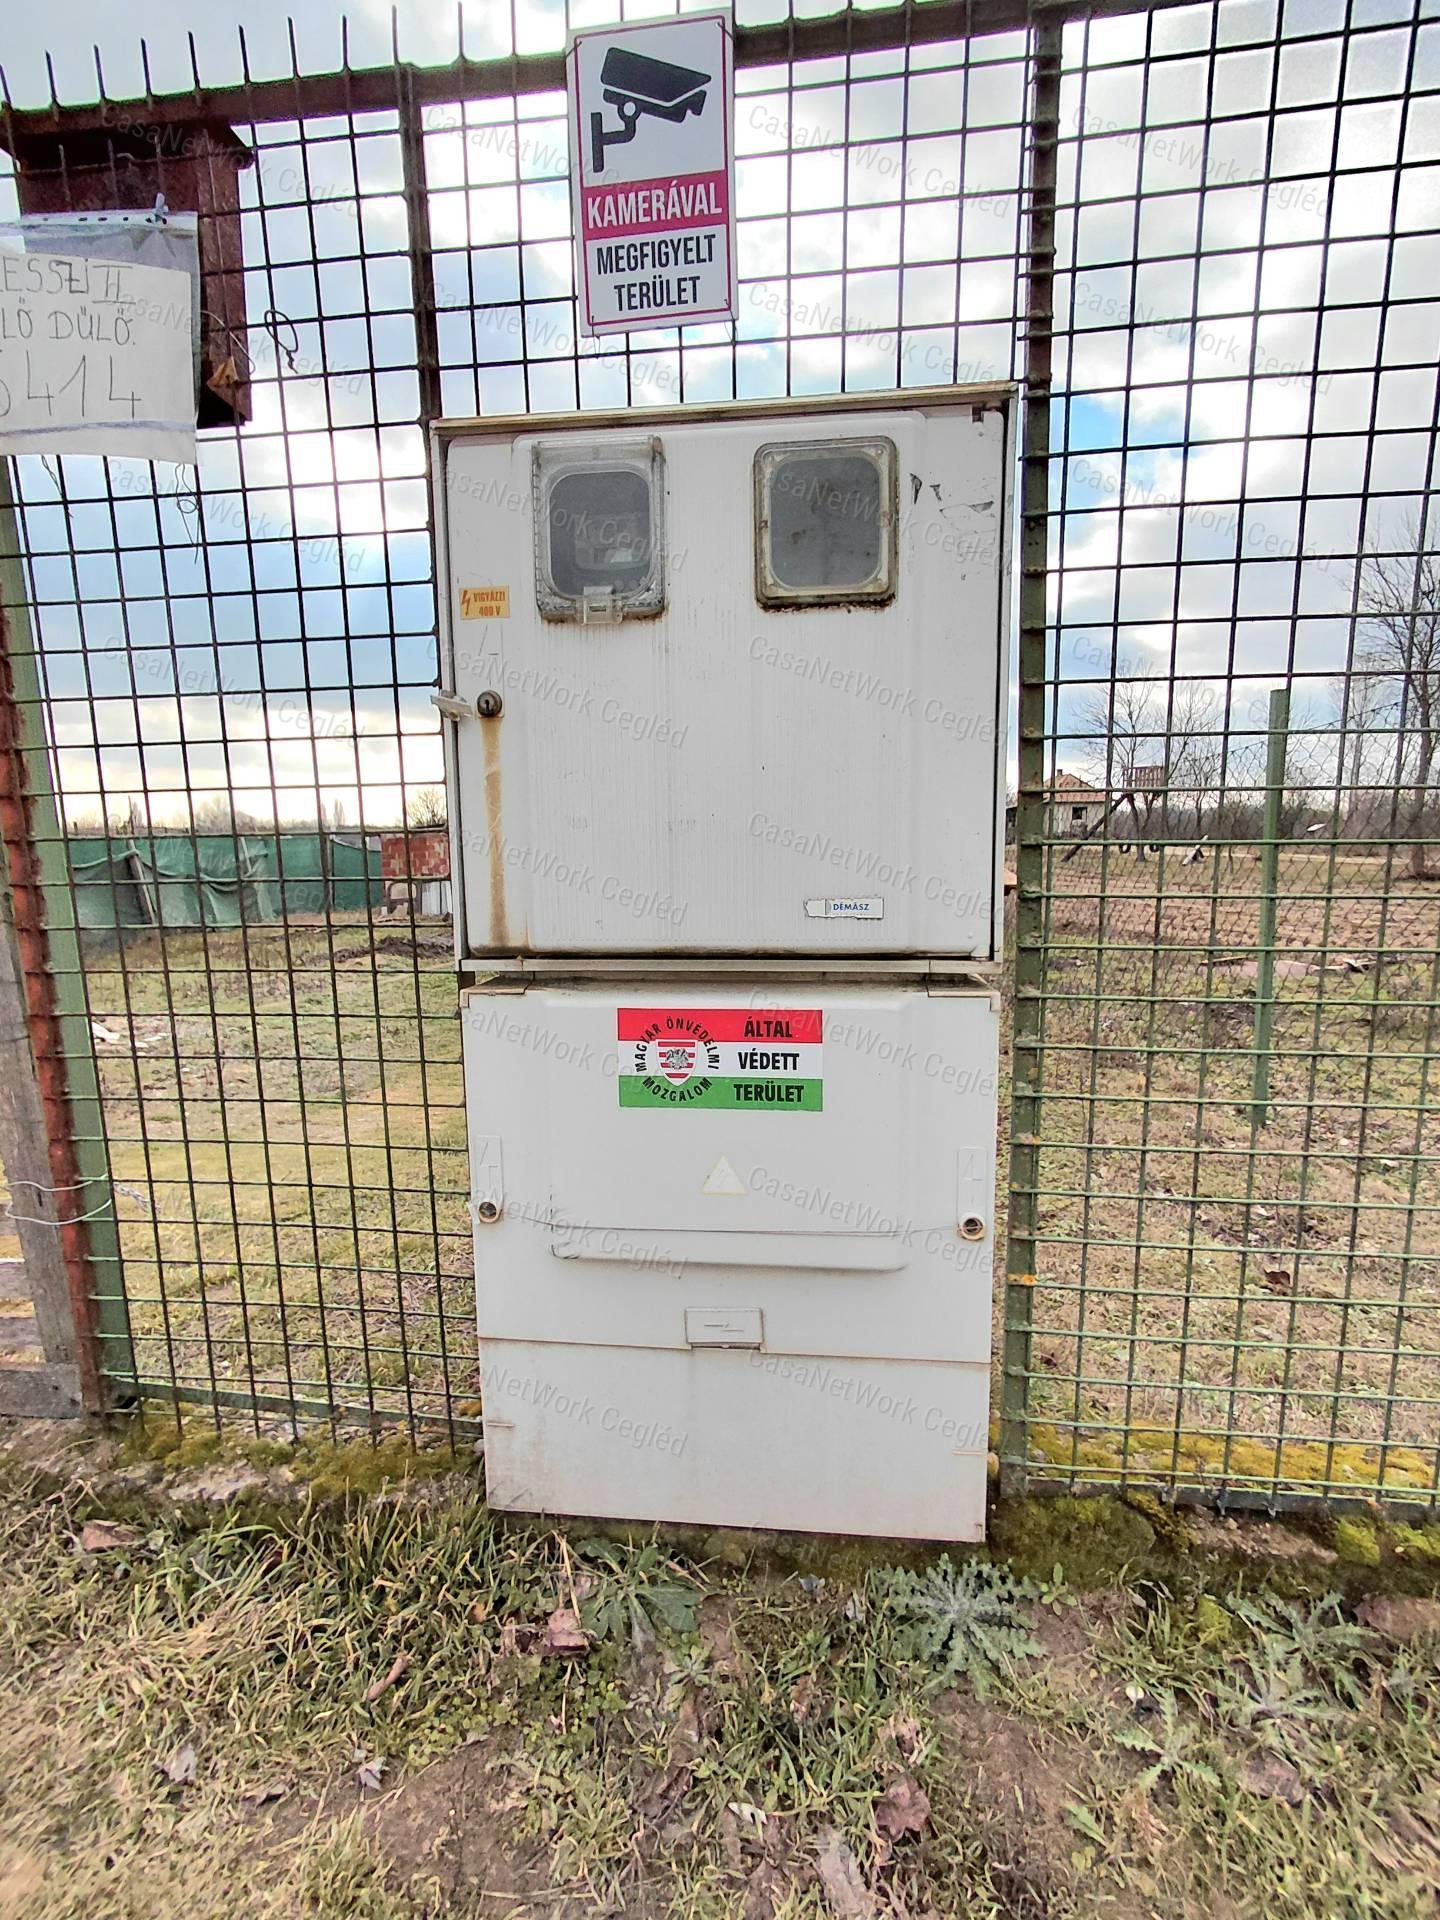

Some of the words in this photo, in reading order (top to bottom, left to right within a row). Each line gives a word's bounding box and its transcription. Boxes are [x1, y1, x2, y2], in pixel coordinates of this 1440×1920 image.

[587, 179, 722, 229] KAMERÁVAL
[596, 233, 716, 275] MEGFIGYELT
[613, 275, 701, 312] TERÜLET
[833, 902, 869, 911] DÉMÁSZ
[743, 1016, 793, 1038] ÁLTAL
[634, 1023, 662, 1073] MAGYAR
[666, 1016, 720, 1070] ÖNVÉDELMI
[738, 1048, 800, 1071] VÉDETT
[642, 1077, 713, 1102] MOZGALOM
[733, 1081, 805, 1103] TERÜLET
